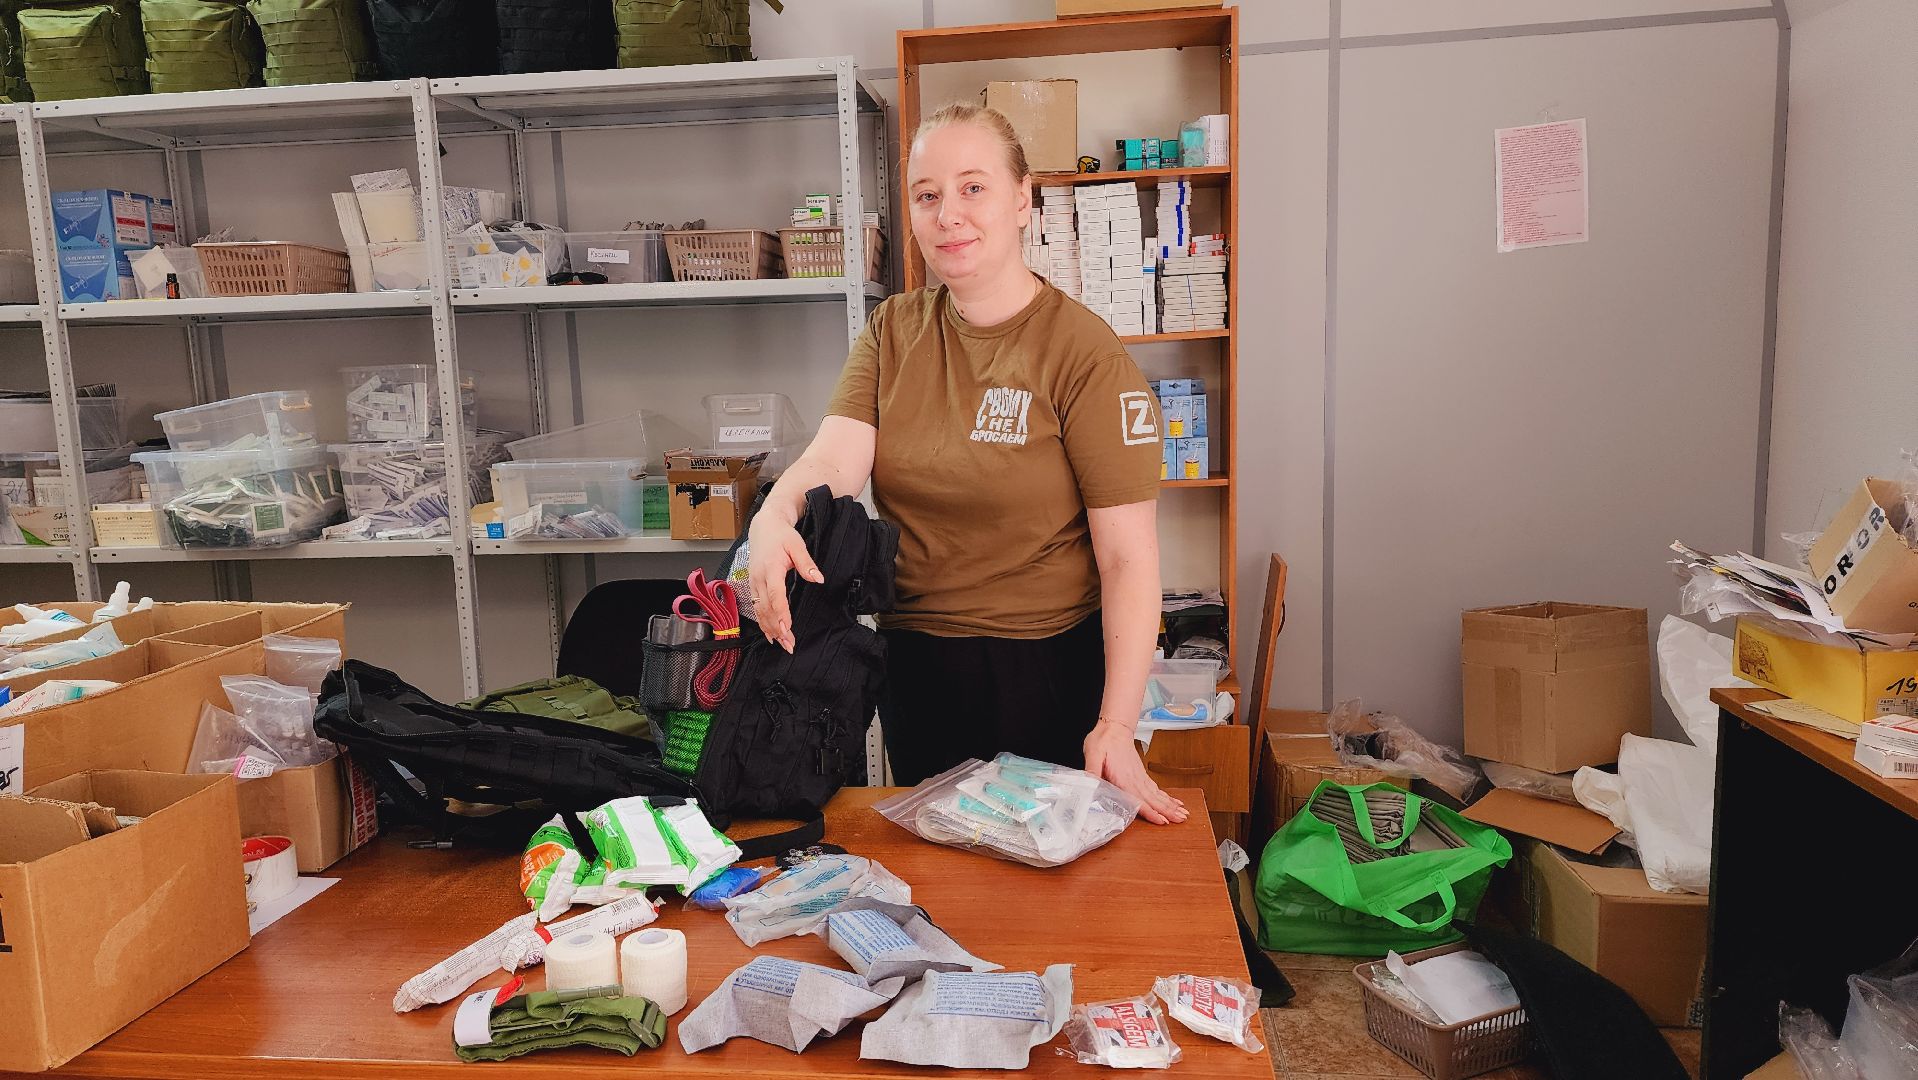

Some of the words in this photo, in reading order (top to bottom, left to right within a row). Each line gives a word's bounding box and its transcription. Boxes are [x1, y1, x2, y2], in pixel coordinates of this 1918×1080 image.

[989, 418, 1014, 432] НЕ
[1128, 400, 1155, 435] Z
[970, 429, 1028, 445] БРОСАЕМ
